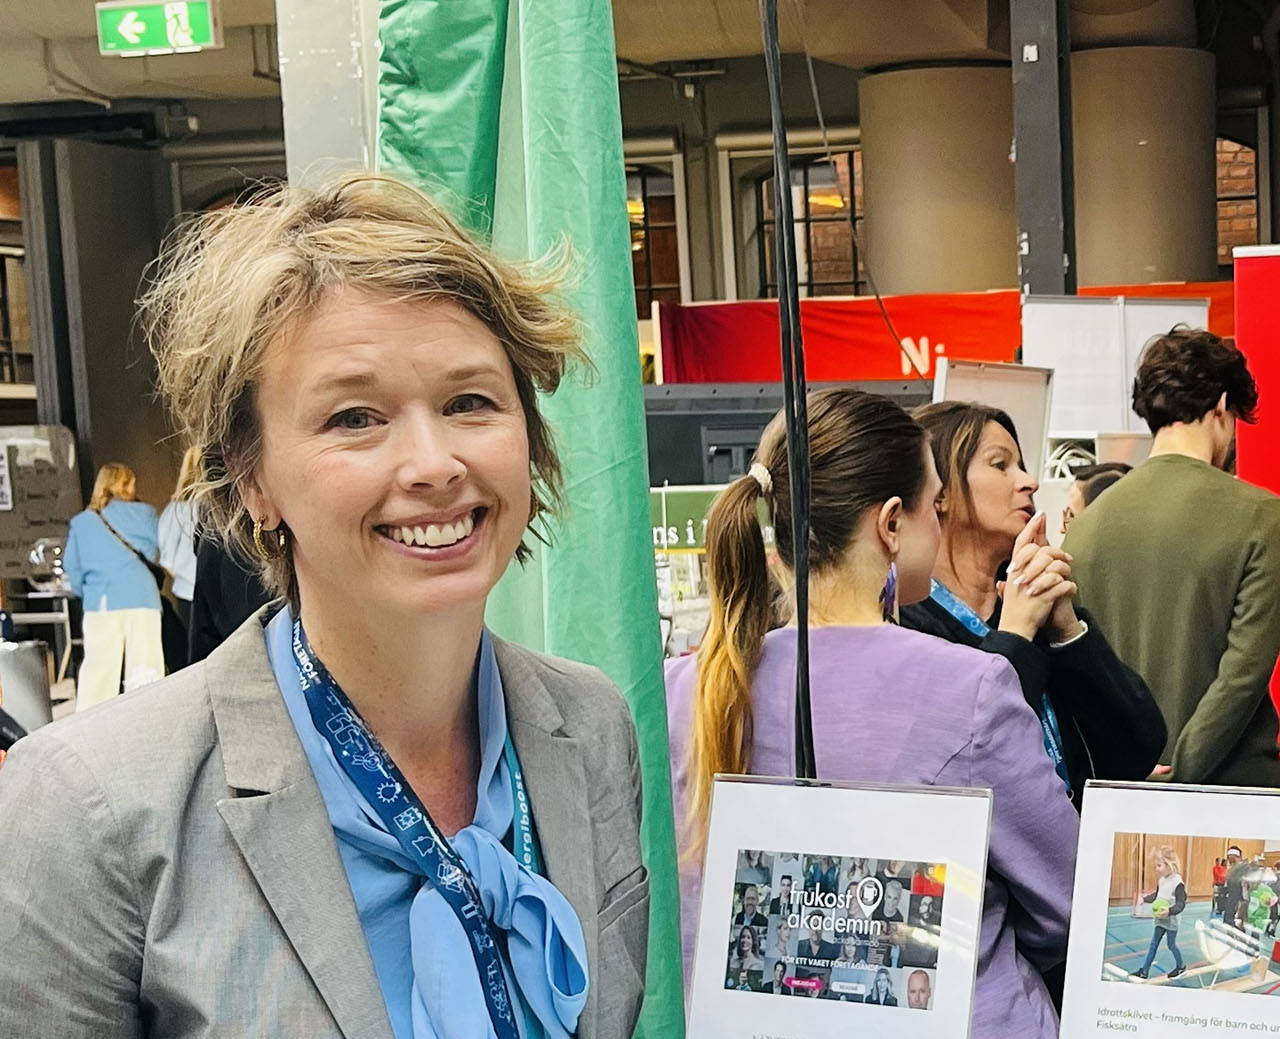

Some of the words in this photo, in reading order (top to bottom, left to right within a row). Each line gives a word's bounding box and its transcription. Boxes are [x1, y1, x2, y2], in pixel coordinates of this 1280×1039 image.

[789, 879, 853, 909] frukost
[787, 905, 881, 936] akademin
[1161, 1013, 1207, 1028] framgång
[1210, 1016, 1223, 1028] för
[1226, 1018, 1247, 1030] barn
[1250, 1021, 1267, 1032] och
